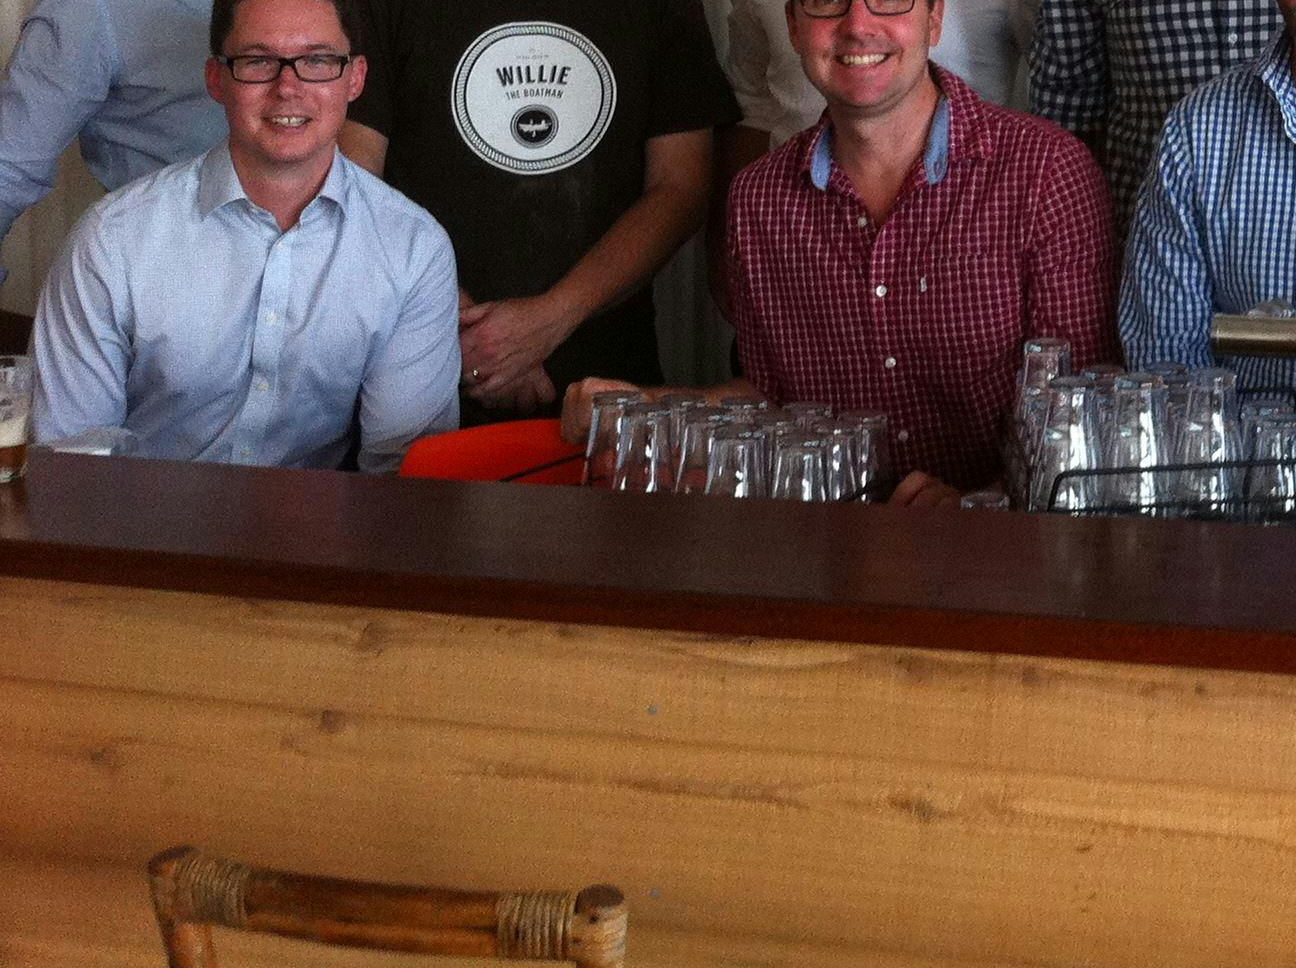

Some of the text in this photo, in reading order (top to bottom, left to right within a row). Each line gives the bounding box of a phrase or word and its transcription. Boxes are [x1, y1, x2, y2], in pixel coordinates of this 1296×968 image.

[496, 64, 572, 87] WILLIE
[505, 87, 564, 101] THE BOATMAN
